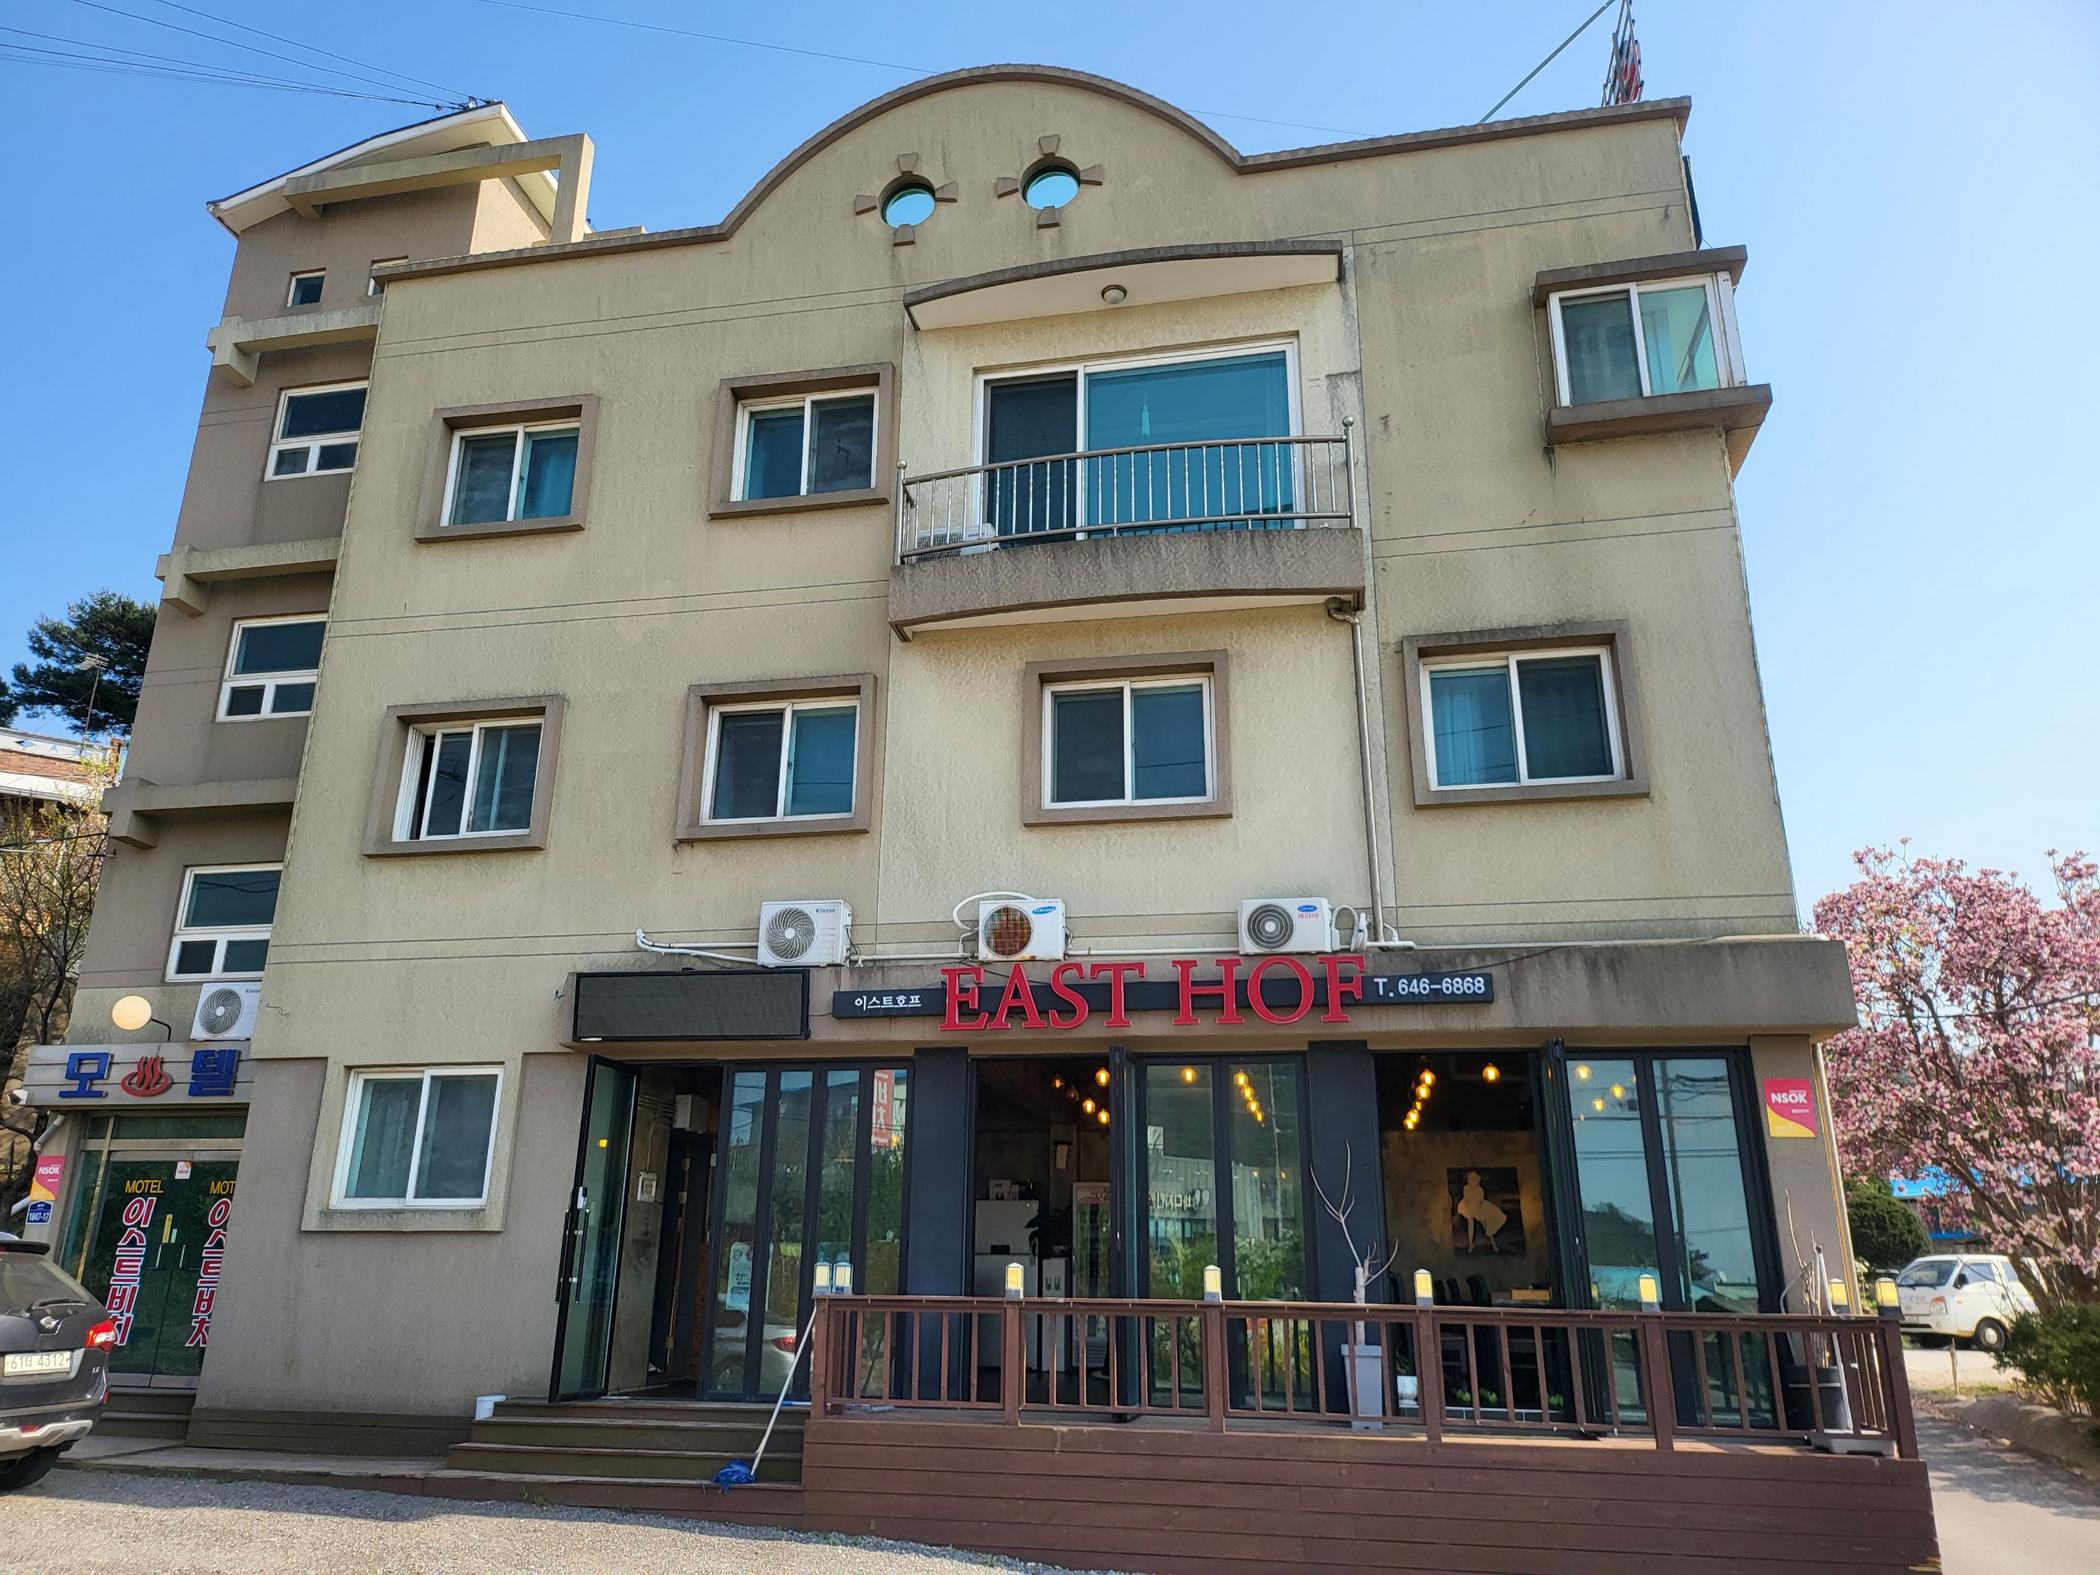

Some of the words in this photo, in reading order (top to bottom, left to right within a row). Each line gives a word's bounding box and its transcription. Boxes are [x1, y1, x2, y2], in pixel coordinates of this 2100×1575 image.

[938, 962, 1145, 1031] EAST
[1172, 955, 1366, 1025] HOF
[854, 994, 922, 1011] 이스트호프
[1771, 1092, 1808, 1104] NSOK
[38, 1166, 60, 1175] NSOK
[125, 1180, 164, 1194] MOTEL
[105, 1197, 157, 1346] 이스트비치
